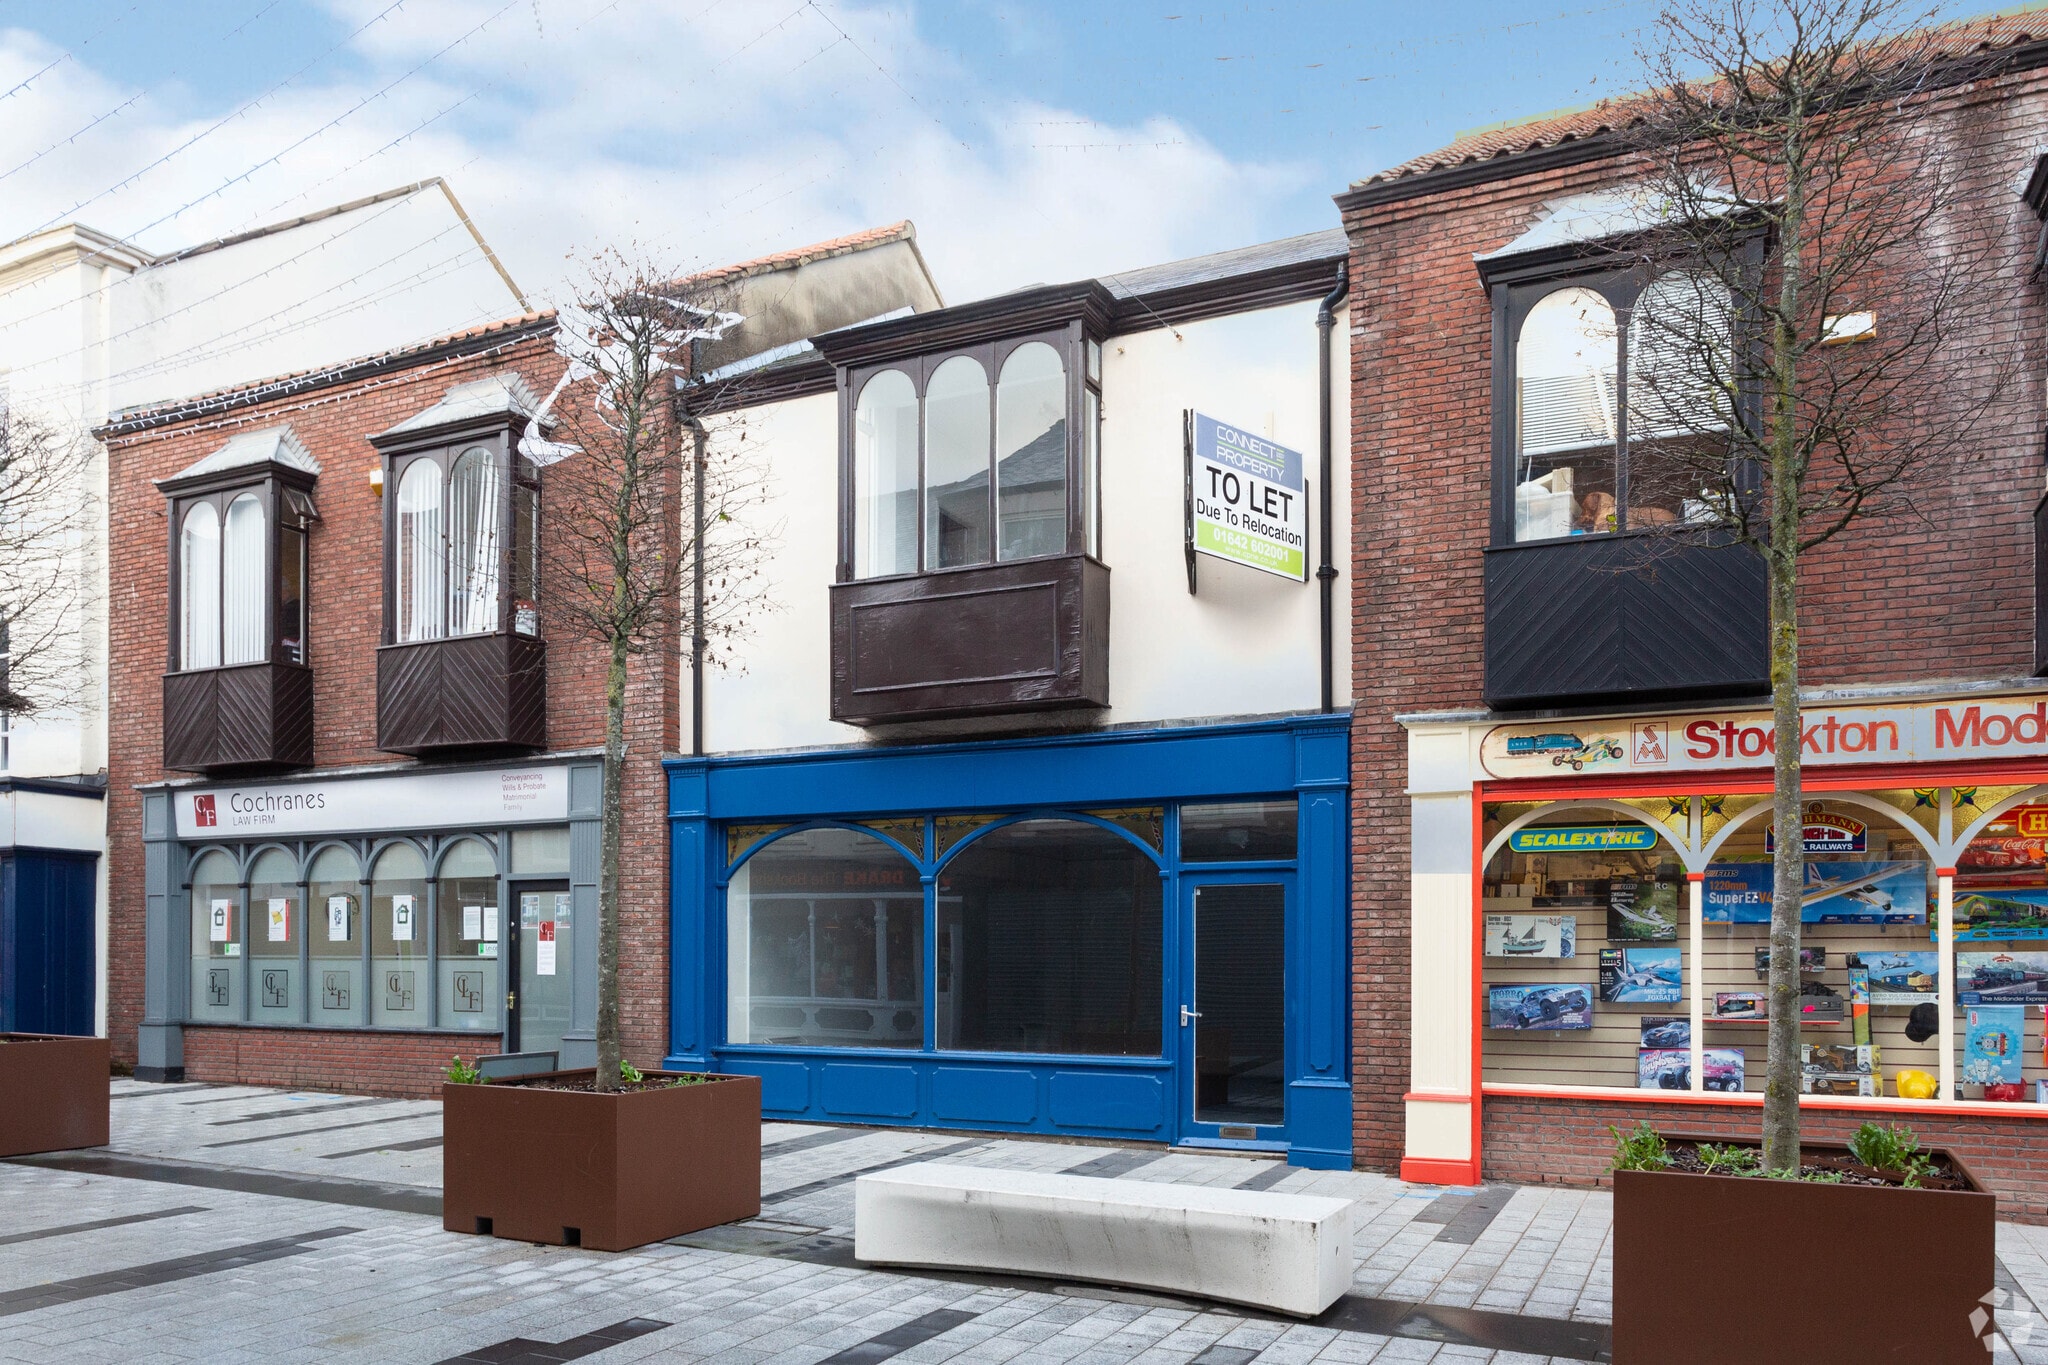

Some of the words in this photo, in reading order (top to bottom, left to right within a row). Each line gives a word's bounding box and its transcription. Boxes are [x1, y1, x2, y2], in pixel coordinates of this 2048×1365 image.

[1216, 425, 1276, 459] CONNECT
[1216, 445, 1284, 481] PROPERTY
[1206, 465, 1240, 505] TO
[1250, 481, 1293, 522] LET
[1197, 498, 1221, 520] Due
[1224, 507, 1238, 526] To
[1242, 513, 1302, 547] Relocation
[1213, 527, 1248, 550] 01642
[1250, 539, 1289, 563] 602001
[1935, 702, 2048, 748] Mod
[501, 774, 543, 782] Conveyancing
[523, 782, 547, 790] Probate
[231, 791, 325, 813] Cochranes
[502, 793, 537, 801] Matrimonial
[503, 803, 522, 811] Family
[233, 816, 251, 826] LAW
[253, 815, 276, 825] FIRM
[1518, 830, 1646, 847] SCALEXTRIC
[1809, 843, 1853, 851] RAILWAYS
[1654, 882, 1668, 890] RC
[1709, 881, 1748, 890] 1220mm
